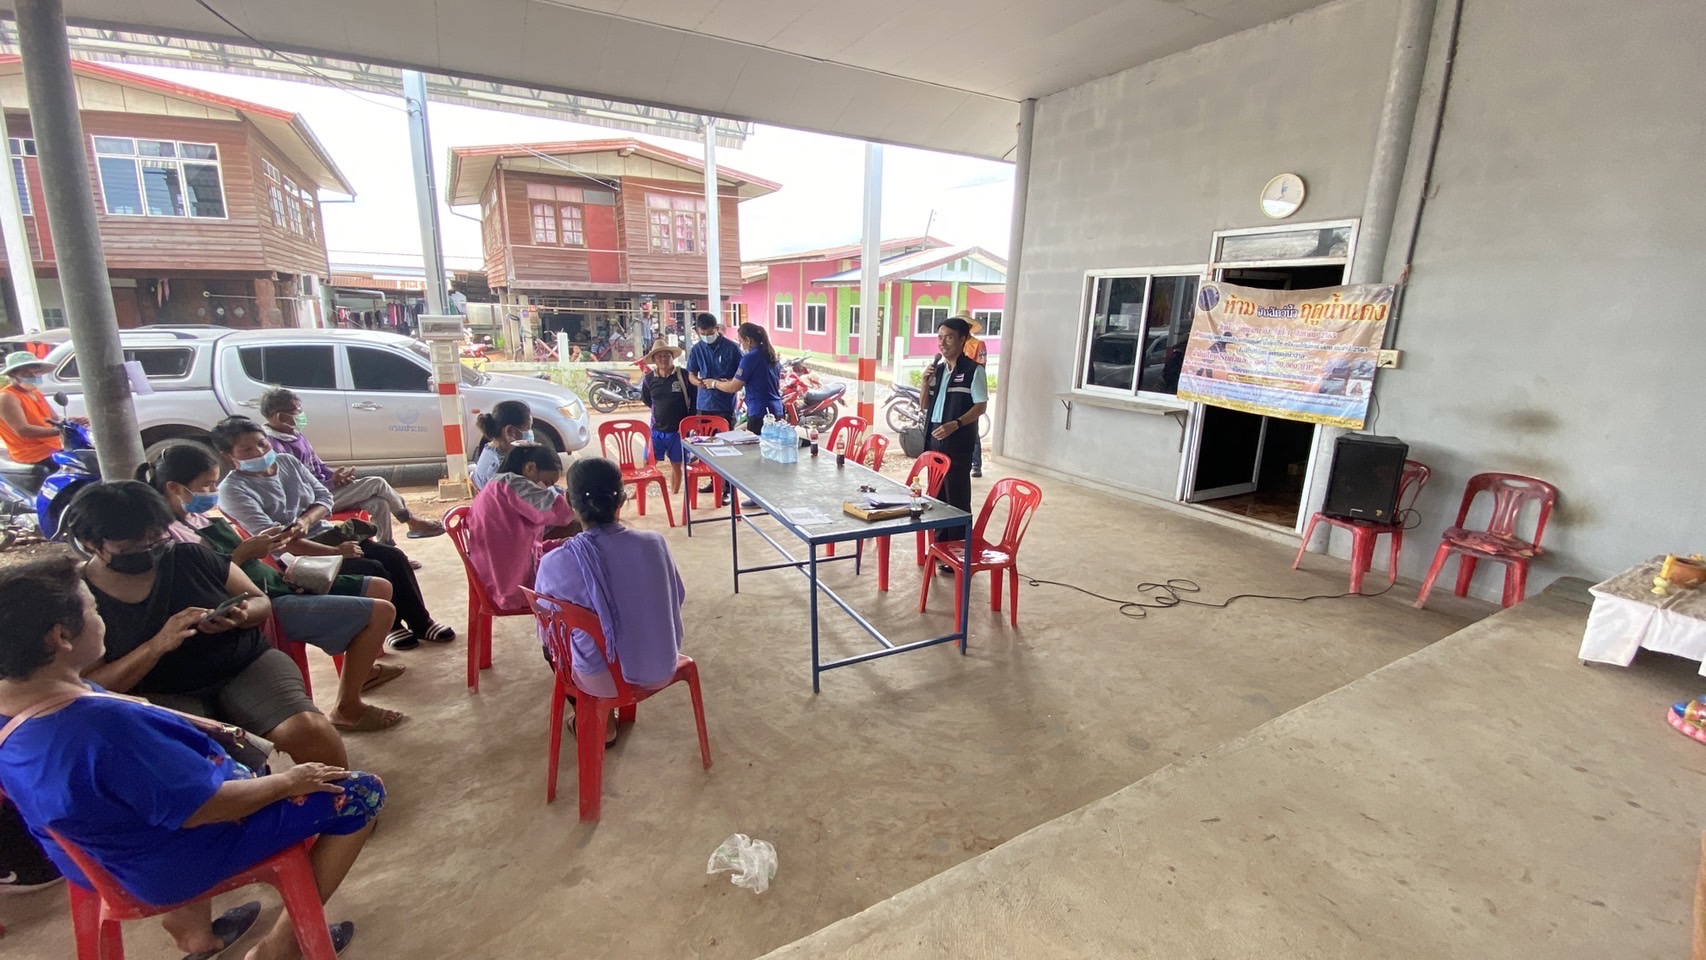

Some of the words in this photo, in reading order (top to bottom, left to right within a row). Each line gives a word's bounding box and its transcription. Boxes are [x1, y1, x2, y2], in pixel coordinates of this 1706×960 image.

[1223, 294, 1256, 316] ห้าม
[1300, 293, 1387, 325] ฤดูน้ำแดง
